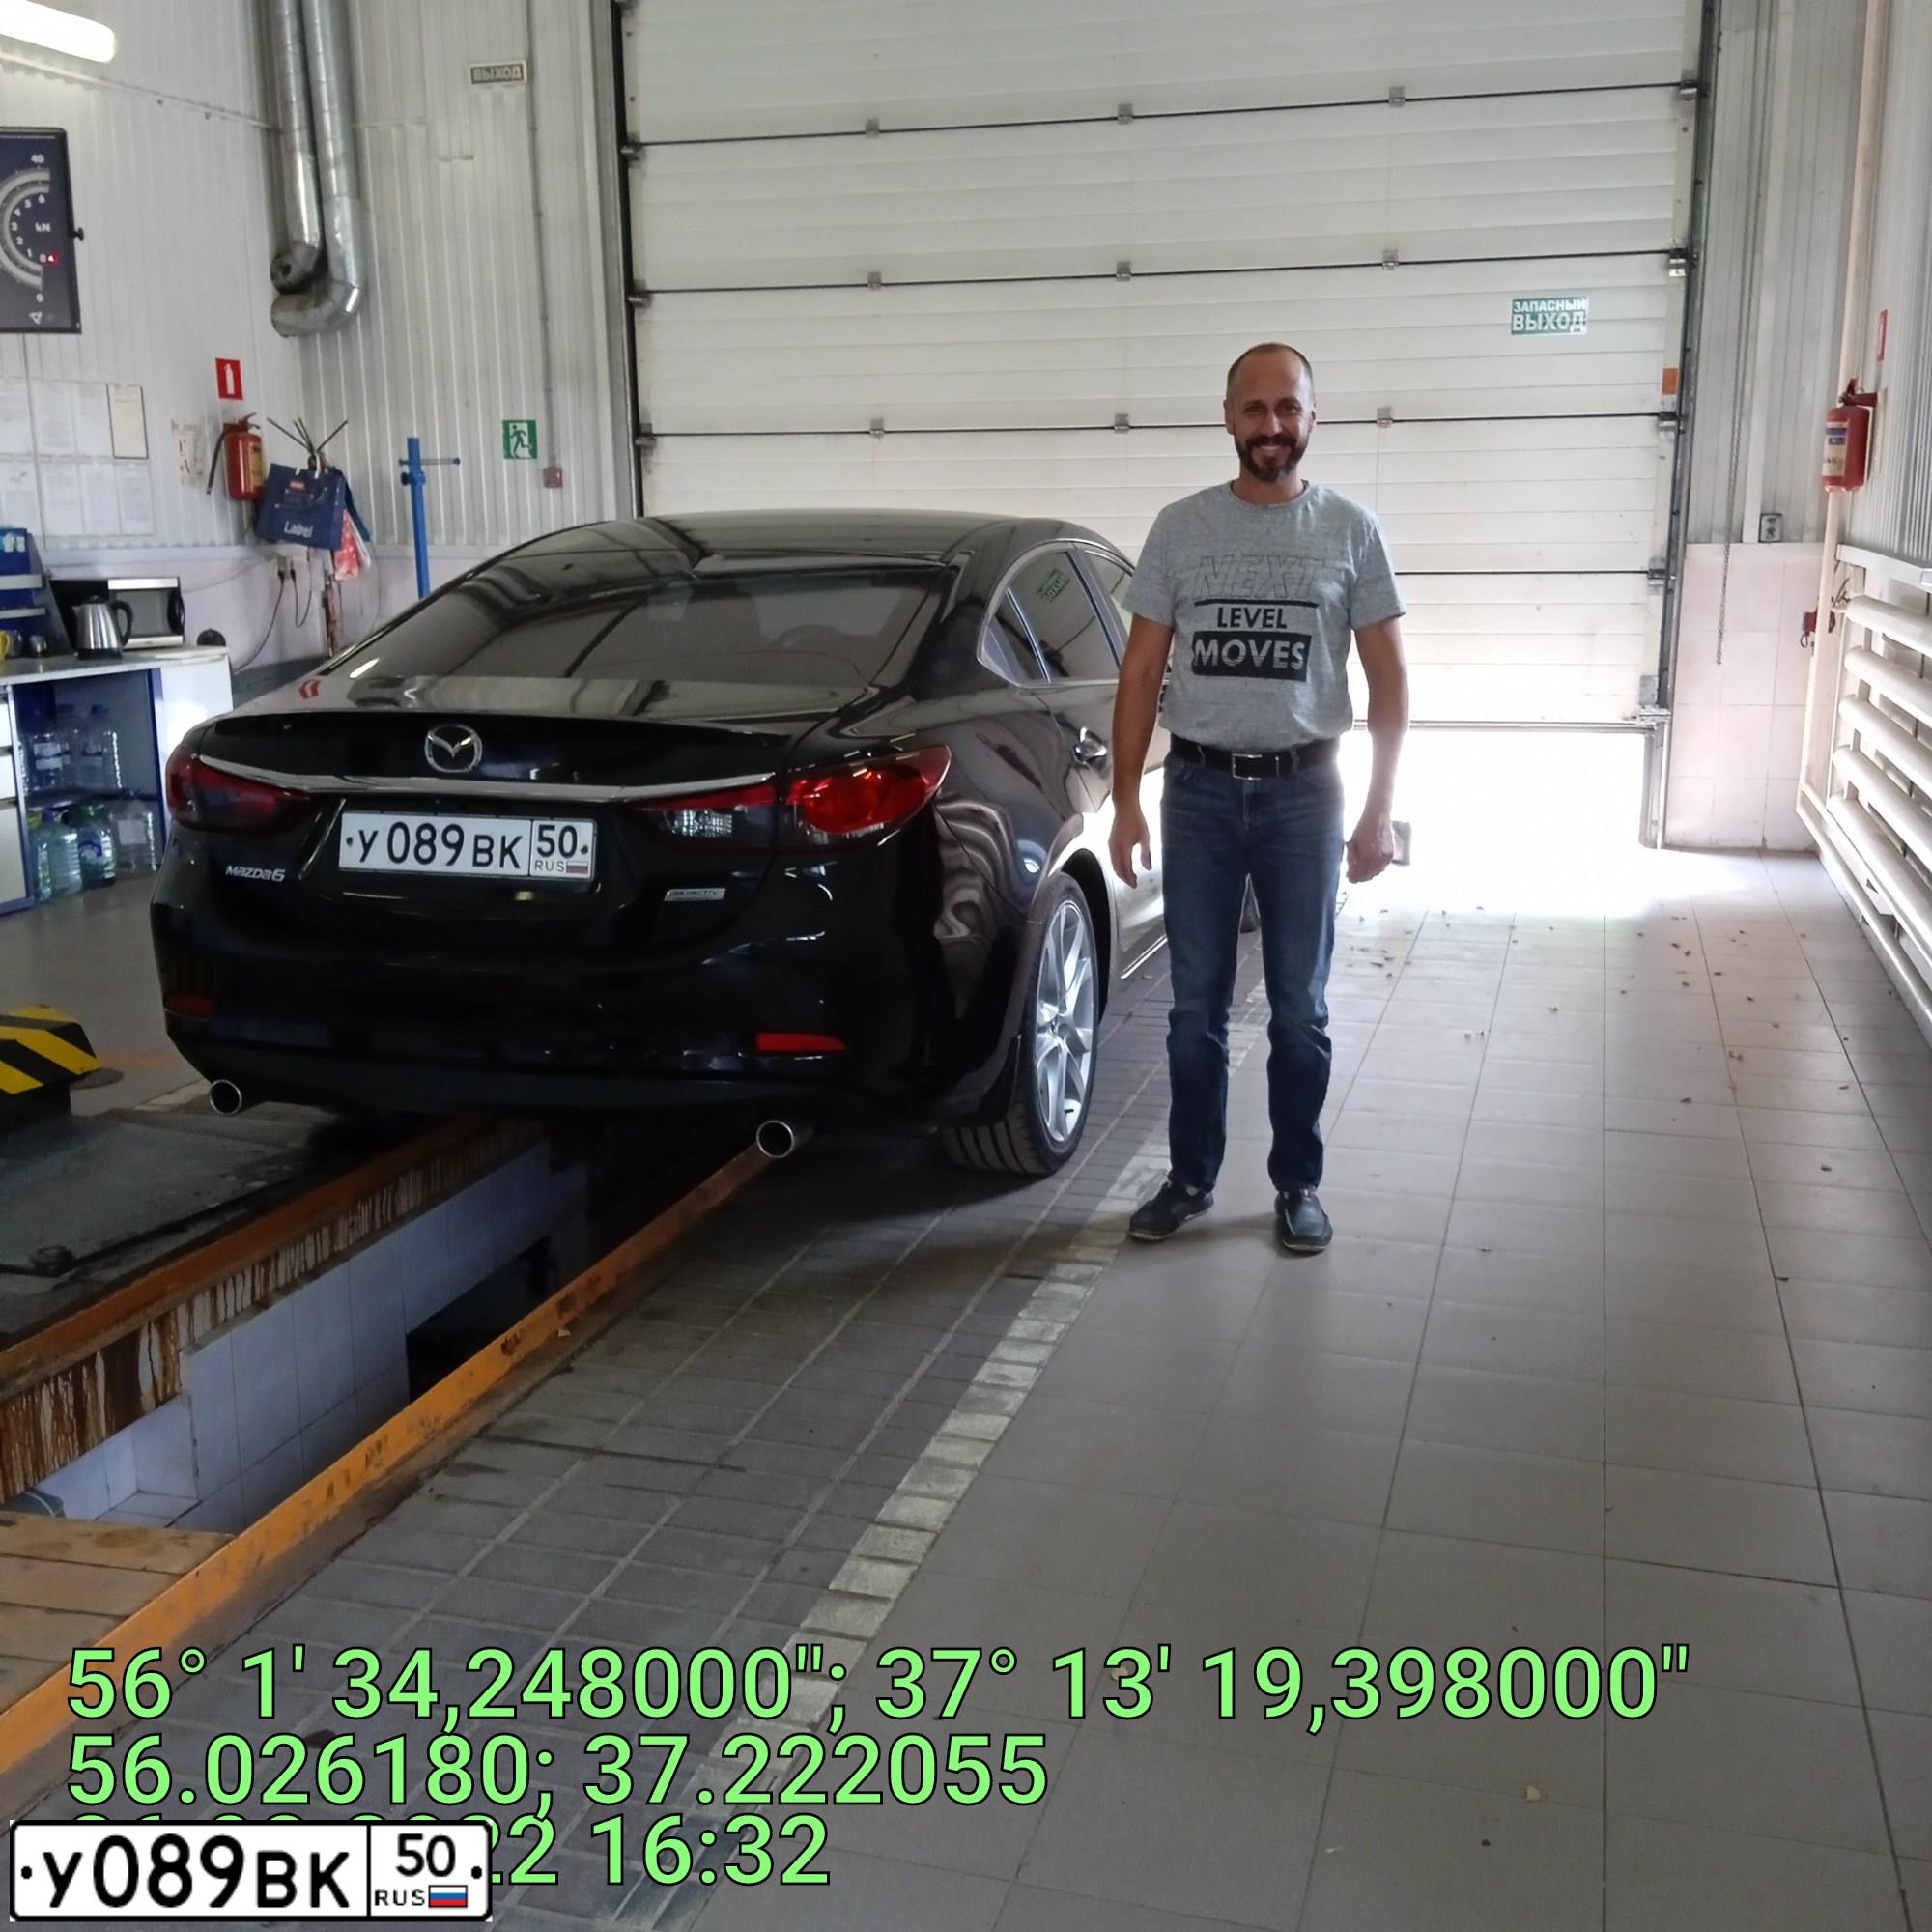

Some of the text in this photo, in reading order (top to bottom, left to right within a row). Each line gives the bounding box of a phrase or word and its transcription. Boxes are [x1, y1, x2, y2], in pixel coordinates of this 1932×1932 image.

[472, 65, 523, 81] ВЫХОД
[1513, 296, 1586, 313] ЗАПАСНЫЙ
[1512, 310, 1585, 333] ВЫХОД
[284, 520, 314, 539] Label
[1192, 554, 1324, 600] NEXT
[1217, 607, 1287, 629] LEVEL
[1194, 639, 1306, 671] MOVES
[536, 824, 579, 858] 50
[534, 860, 565, 872] RUS
